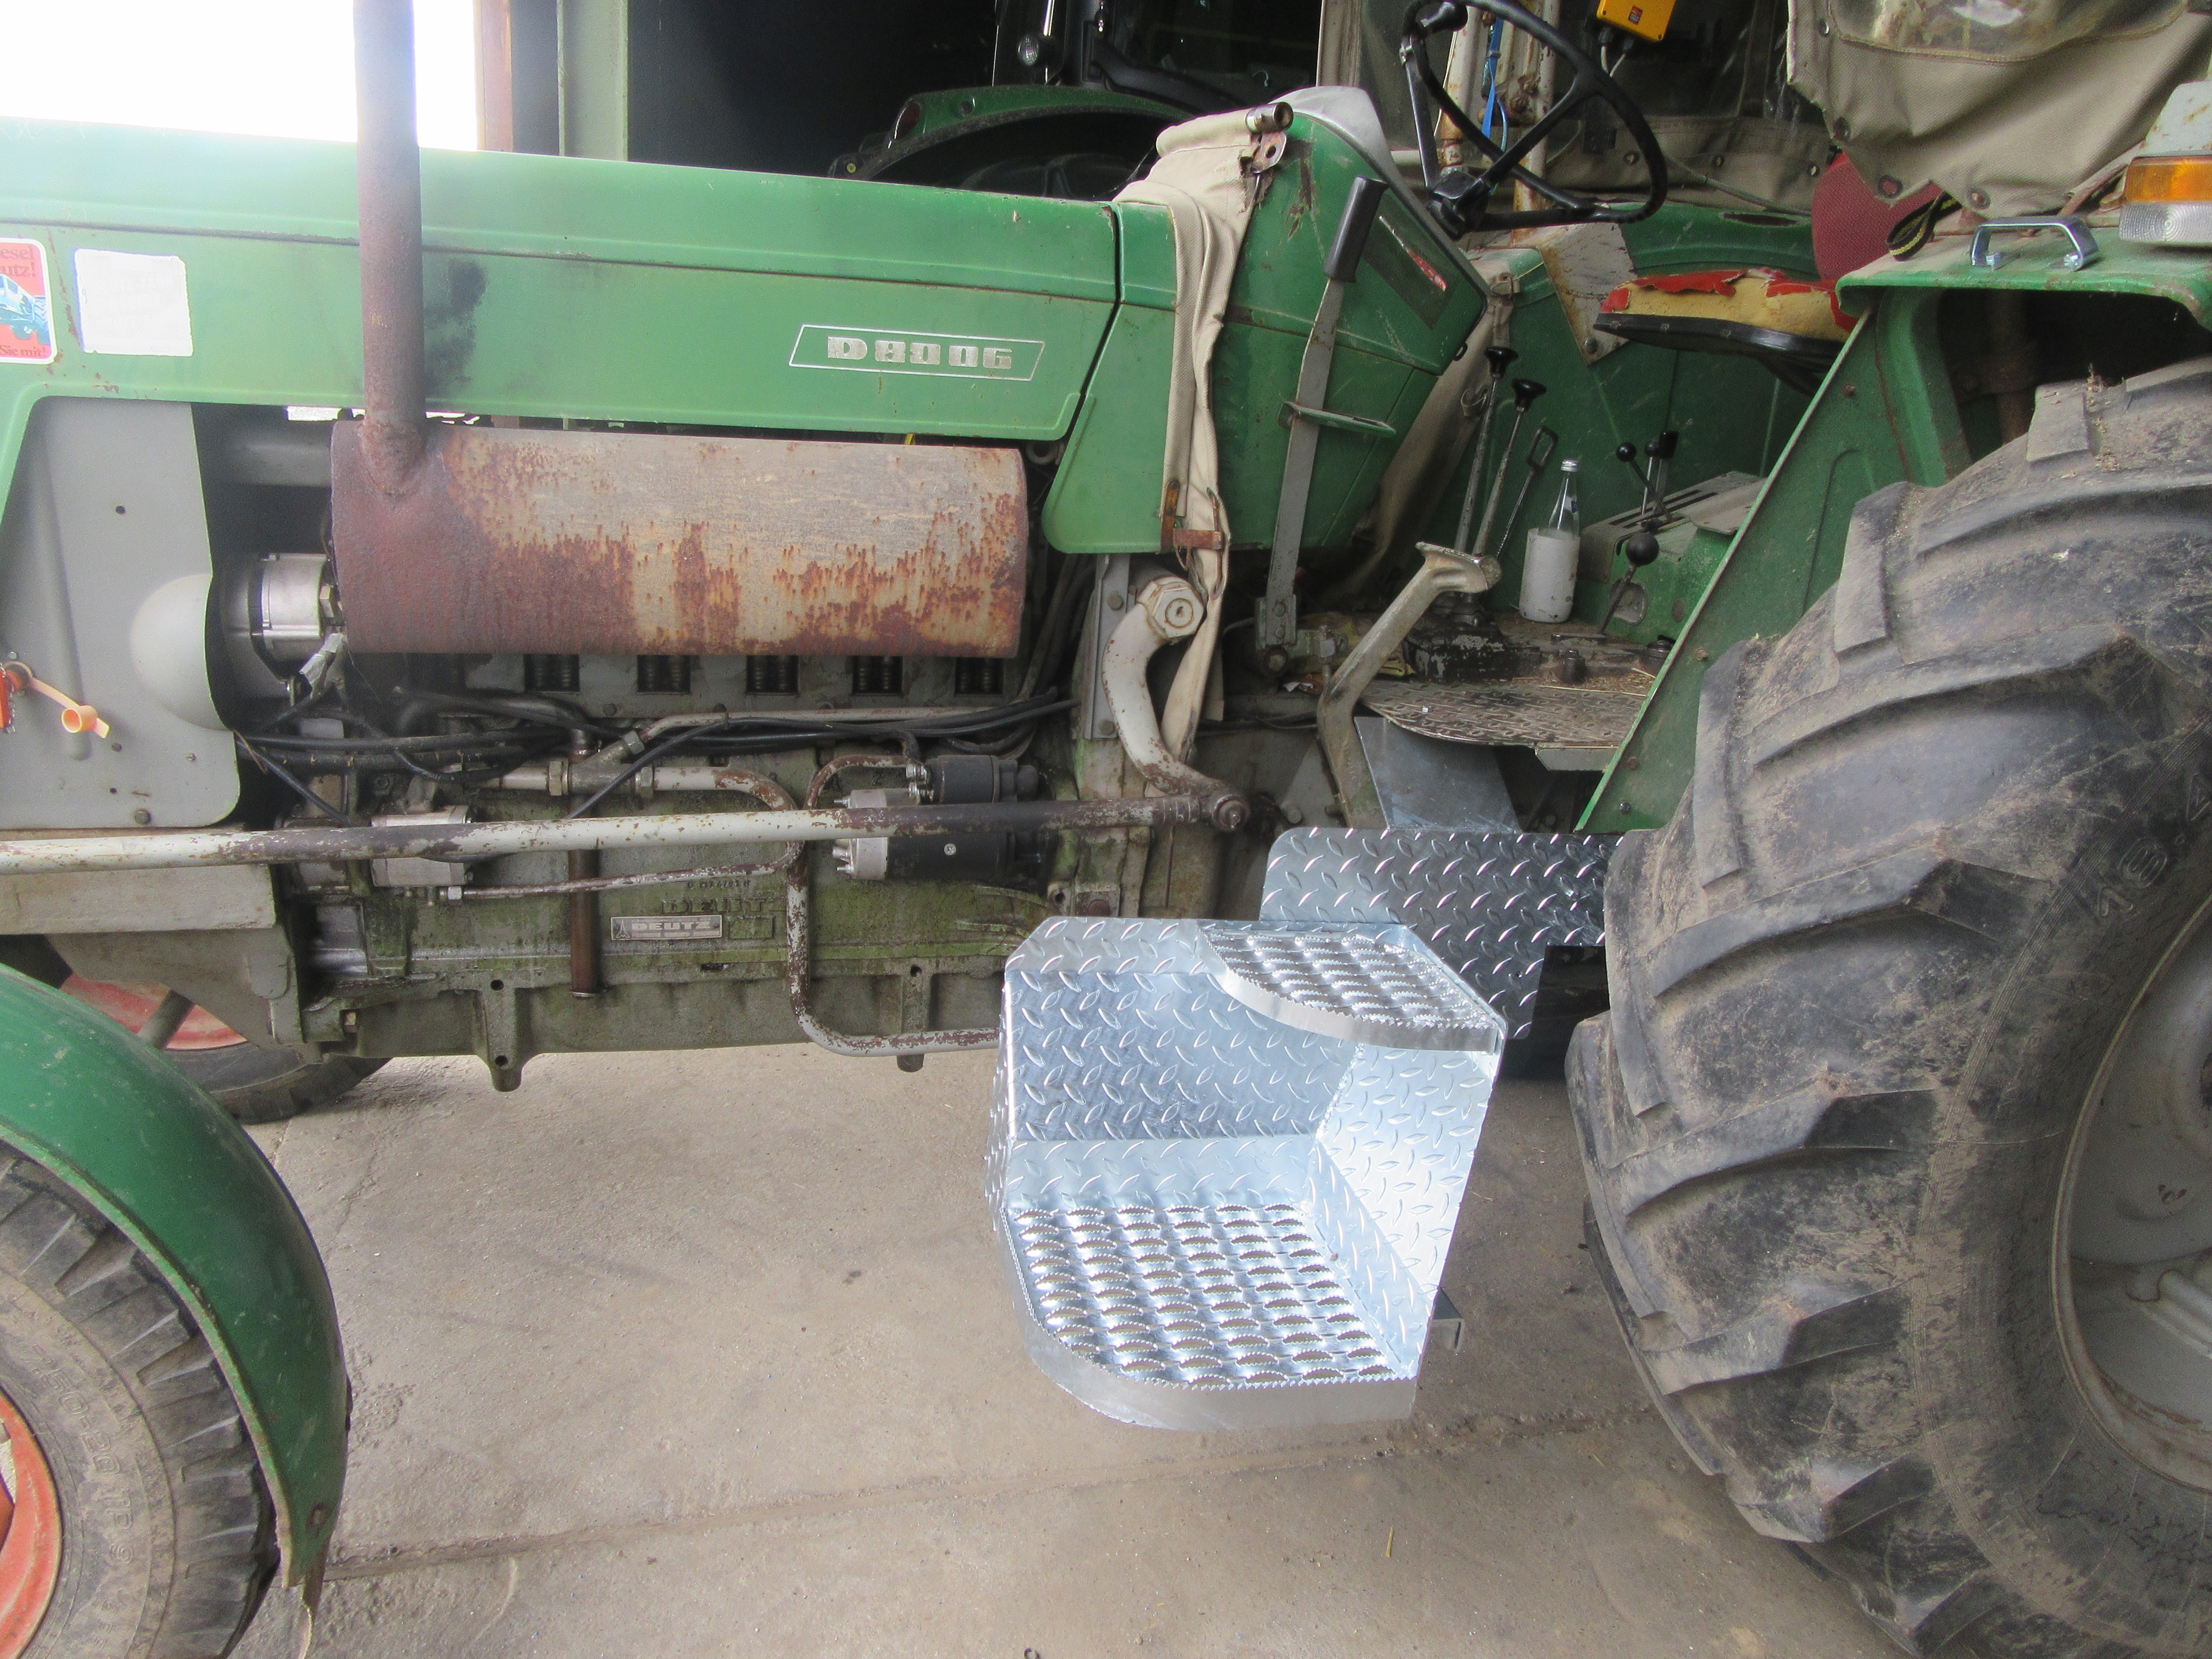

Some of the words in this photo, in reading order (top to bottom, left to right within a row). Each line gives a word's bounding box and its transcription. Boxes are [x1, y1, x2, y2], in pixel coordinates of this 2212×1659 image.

[0, 244, 34, 259] esel
[0, 262, 36, 277] utz!
[632, 921, 710, 931] DEUTZ
